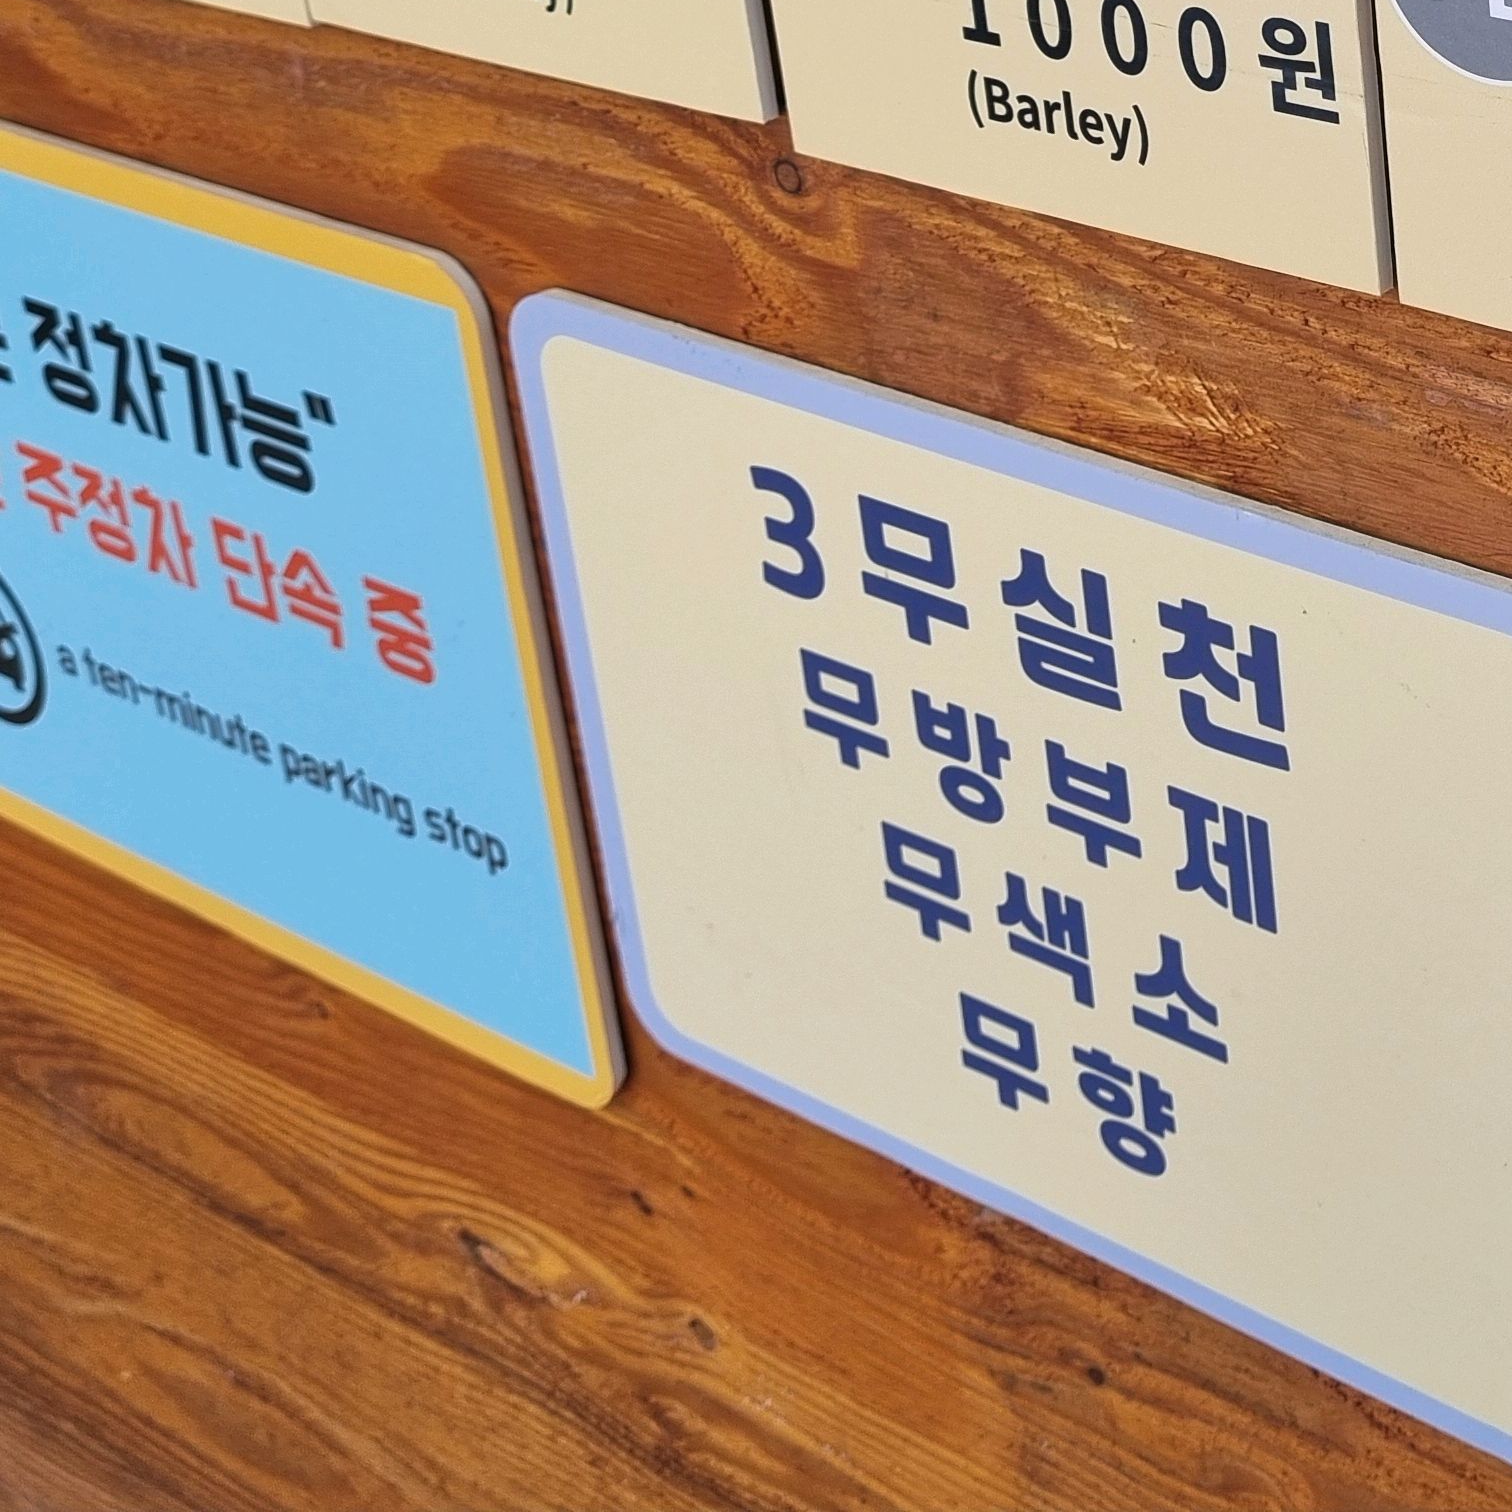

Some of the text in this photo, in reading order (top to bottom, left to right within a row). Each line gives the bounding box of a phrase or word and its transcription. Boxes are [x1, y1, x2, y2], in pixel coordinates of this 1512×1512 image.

[967, 69, 1150, 166] (Barley)
[14, 439, 437, 686] 주정차 단속 중
[57, 645, 509, 875] a ten-minute parking stop
